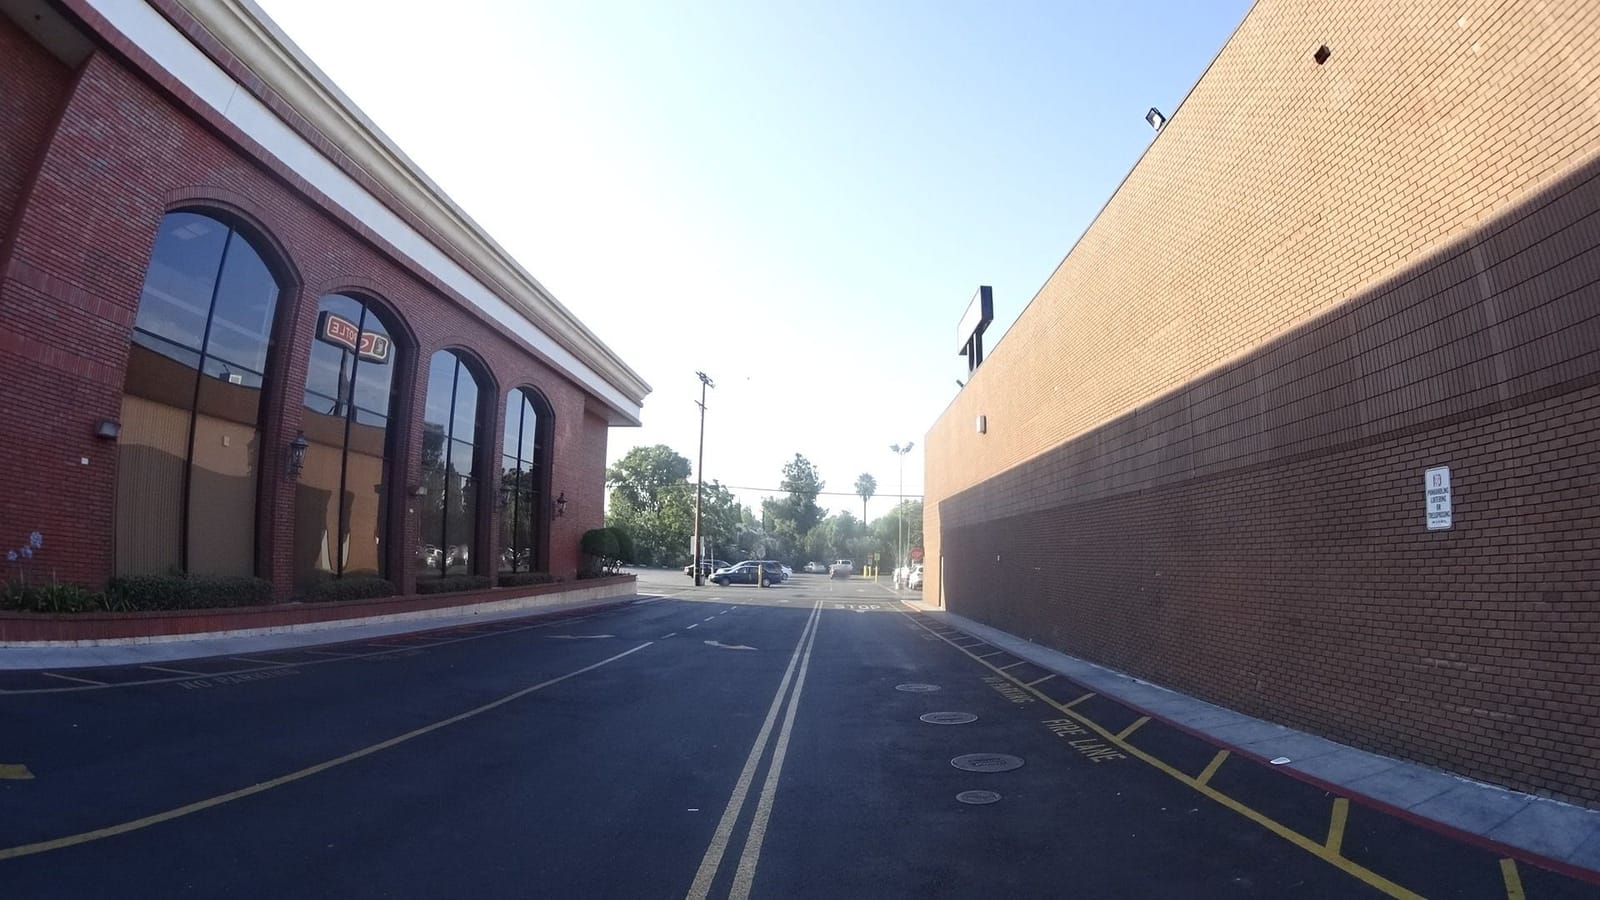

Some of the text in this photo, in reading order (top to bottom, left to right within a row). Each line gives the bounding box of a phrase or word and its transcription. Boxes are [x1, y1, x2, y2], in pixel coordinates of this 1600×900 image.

[177, 679, 213, 690] NO
[1041, 718, 1127, 763] FIRE LANE
